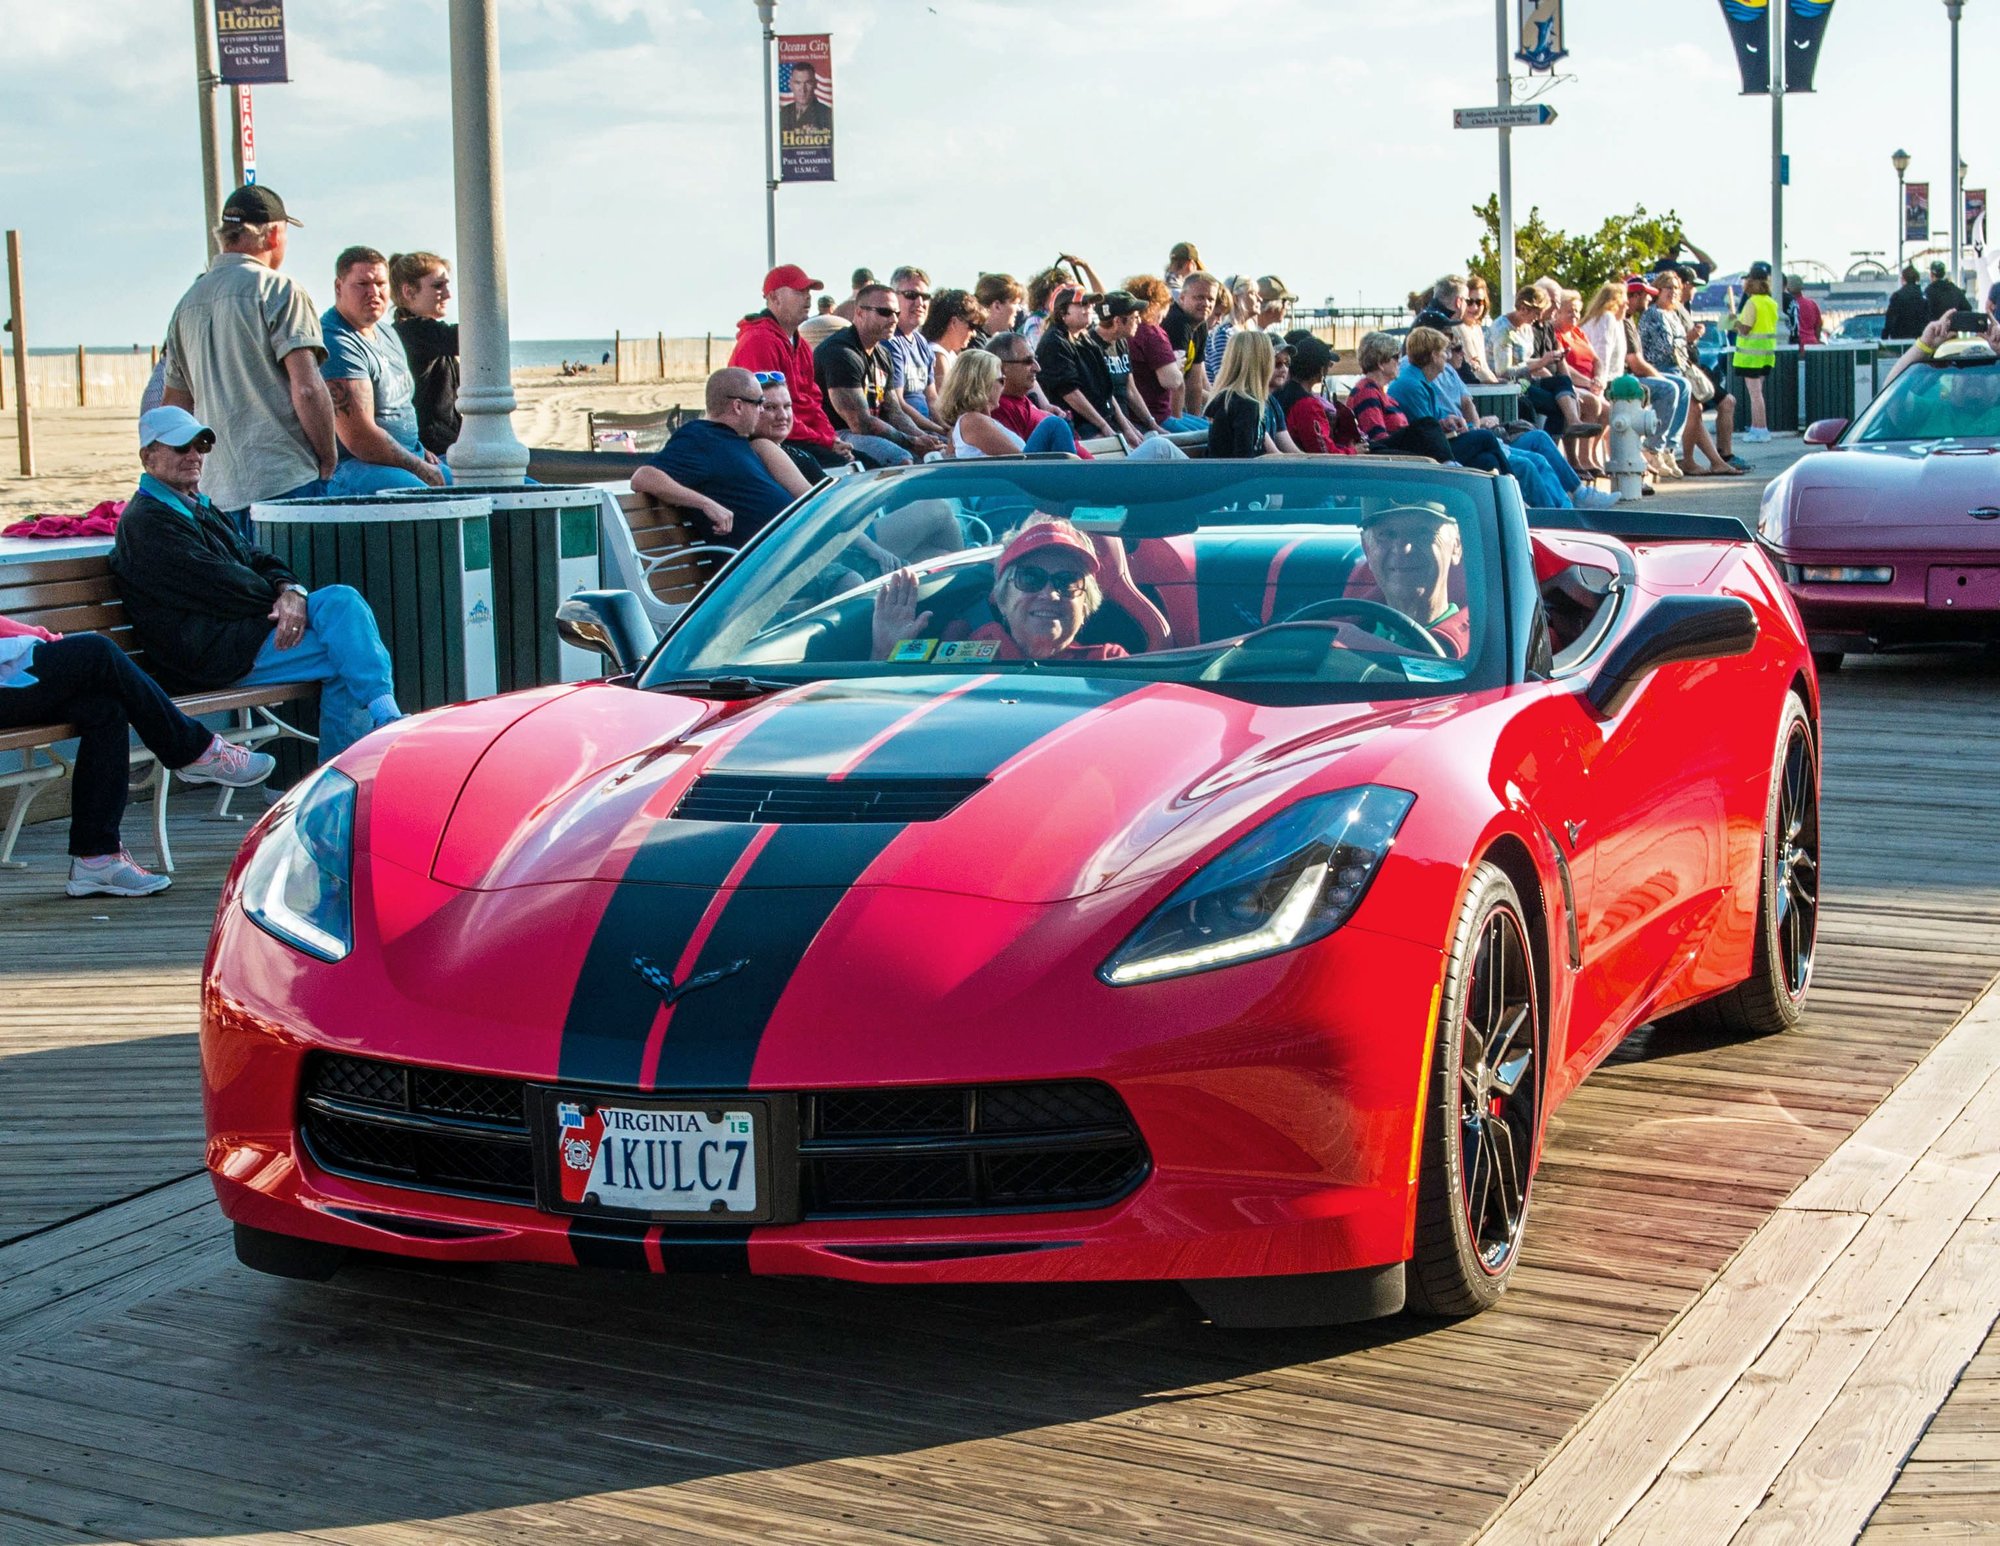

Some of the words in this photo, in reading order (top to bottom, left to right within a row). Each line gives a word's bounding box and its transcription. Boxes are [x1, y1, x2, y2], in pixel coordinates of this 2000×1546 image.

[234, 7, 248, 16] We
[250, 5, 282, 16] Proudly
[218, 11, 281, 30] Honor
[224, 45, 251, 55] GLENN
[253, 43, 280, 54] STEELE
[779, 41, 807, 53] Ocean
[809, 39, 830, 55] City
[235, 57, 250, 66] U.S.
[242, 85, 254, 159] BEACH
[1500, 115, 1516, 124] Thrift
[1517, 115, 1532, 123] Shop
[782, 130, 832, 146] Honor
[946, 643, 958, 656] 6
[977, 645, 992, 656] 15
[562, 1112, 582, 1127] JUN
[599, 1109, 703, 1133] VIRGINIA
[731, 1121, 749, 1134] 15
[600, 1135, 748, 1191] 1KULC7
